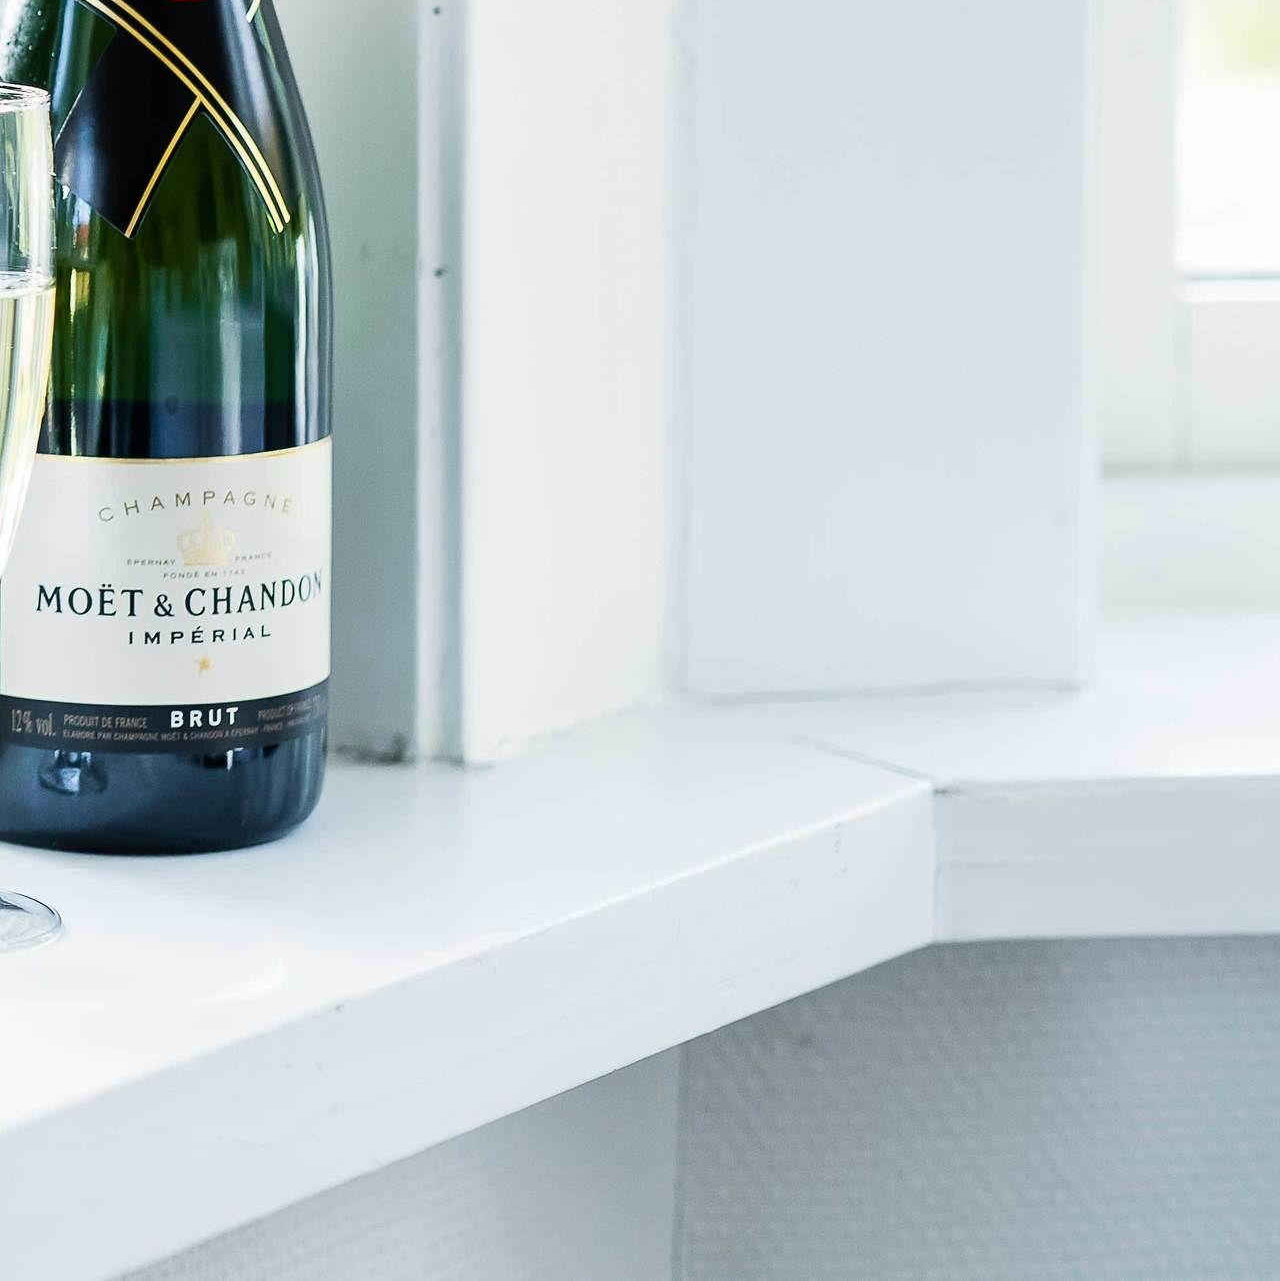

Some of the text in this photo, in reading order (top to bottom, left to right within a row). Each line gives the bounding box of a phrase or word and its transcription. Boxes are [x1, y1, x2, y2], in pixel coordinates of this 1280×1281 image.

[98, 490, 293, 522] CHAMPAGNE
[36, 569, 323, 617] MOËT & CHANDON
[128, 625, 272, 645] IMPÉRIAL
[11, 709, 56, 736] 12% vol.
[63, 714, 148, 729] PRODUIT DE FRANCE
[170, 706, 239, 729] BRUT
